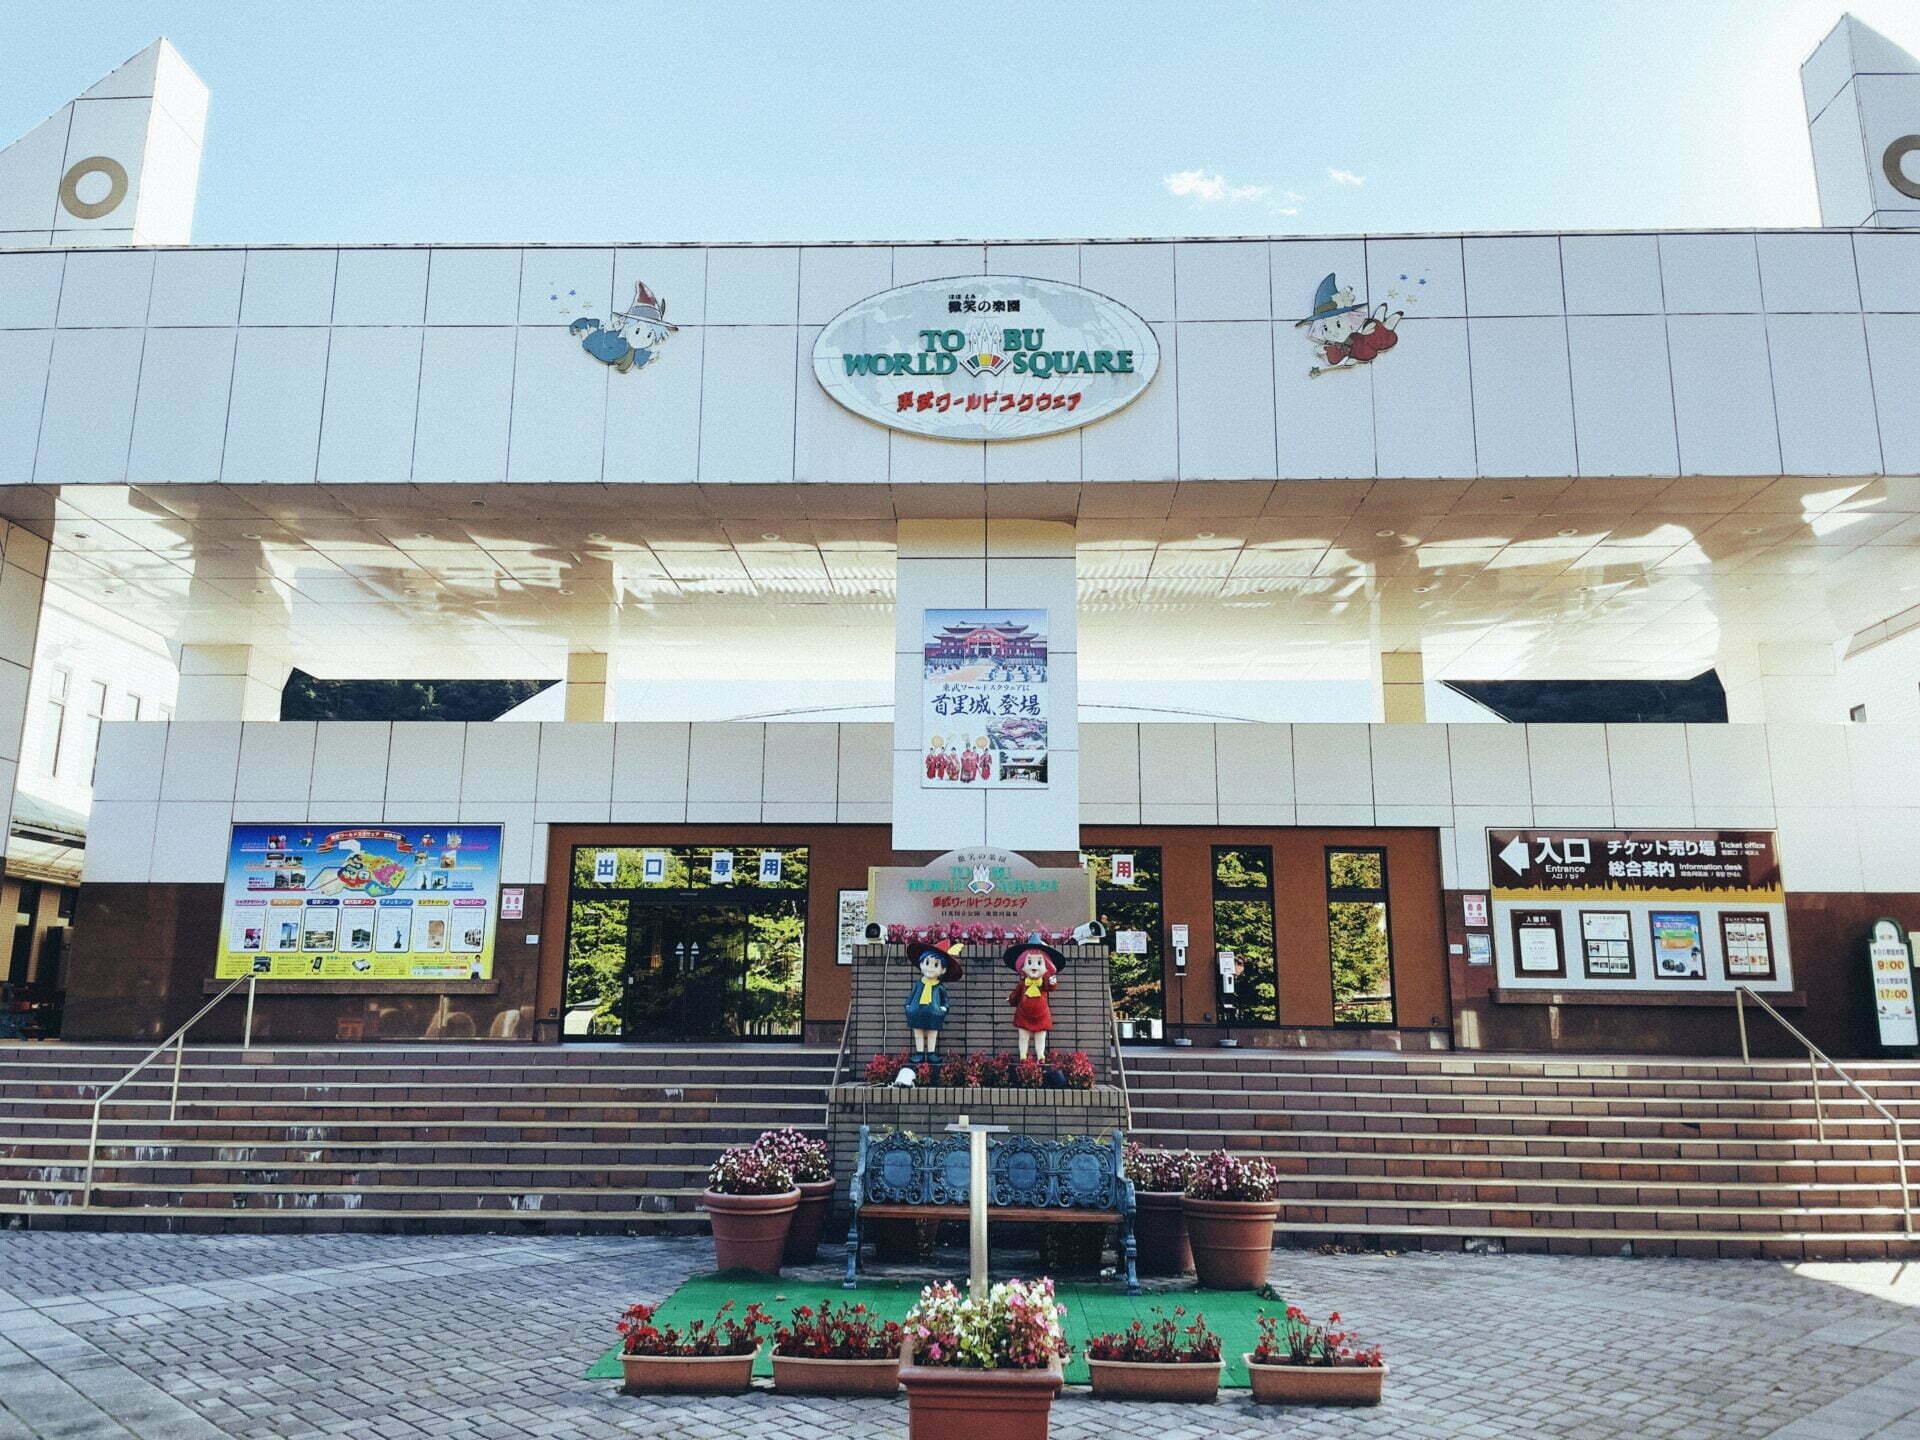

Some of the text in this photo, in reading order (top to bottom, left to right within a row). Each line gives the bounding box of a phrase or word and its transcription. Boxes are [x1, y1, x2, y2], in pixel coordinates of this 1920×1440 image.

[948, 300, 1020, 313] 微笑の楽園
[920, 328, 1045, 352] TO BU
[842, 350, 1134, 379] WORLD SQUARE
[931, 694, 1041, 716] 首里城、登場
[1535, 837, 1591, 864] 入口
[1607, 840, 1716, 857] チケット売り場
[1116, 861, 1131, 878] 用
[1545, 865, 1585, 873] Entrance
[1608, 861, 1675, 877] 総合案内
[1877, 960, 1904, 970] 9:00
[1880, 989, 1908, 999] 17:00
